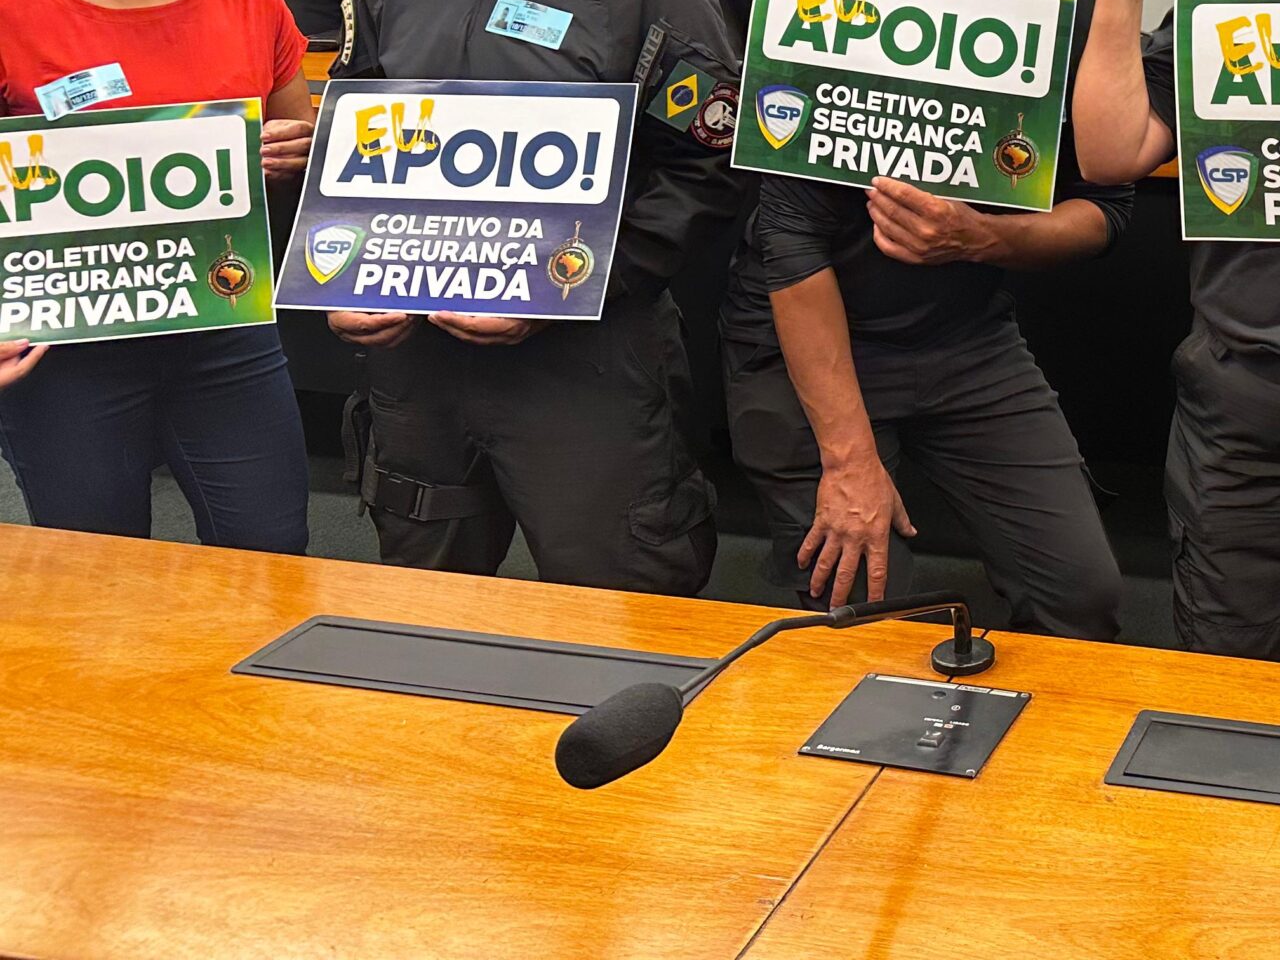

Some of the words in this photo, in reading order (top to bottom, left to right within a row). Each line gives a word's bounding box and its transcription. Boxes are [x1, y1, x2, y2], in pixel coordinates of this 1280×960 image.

[765, 103, 800, 121] CSP
[815, 83, 943, 121] COLETIVO
[950, 103, 986, 127] DA
[355, 98, 438, 157] EU
[812, 108, 983, 156] SEGURANÇA
[336, 129, 601, 191] APOIO!
[808, 133, 979, 187] PRIVADA
[1209, 168, 1248, 183] CSP
[0, 149, 234, 222] POIO!
[370, 213, 504, 238] COLETIVO
[508, 218, 543, 239] DA
[3, 241, 148, 272] COLETIVO
[157, 237, 195, 259] DA
[314, 240, 352, 254] CSP
[362, 238, 538, 270] SEGURANÇA
[2, 262, 197, 299] SEGURANÇA
[354, 264, 531, 301] PRIVADA
[0, 287, 199, 333] PRIVADA
